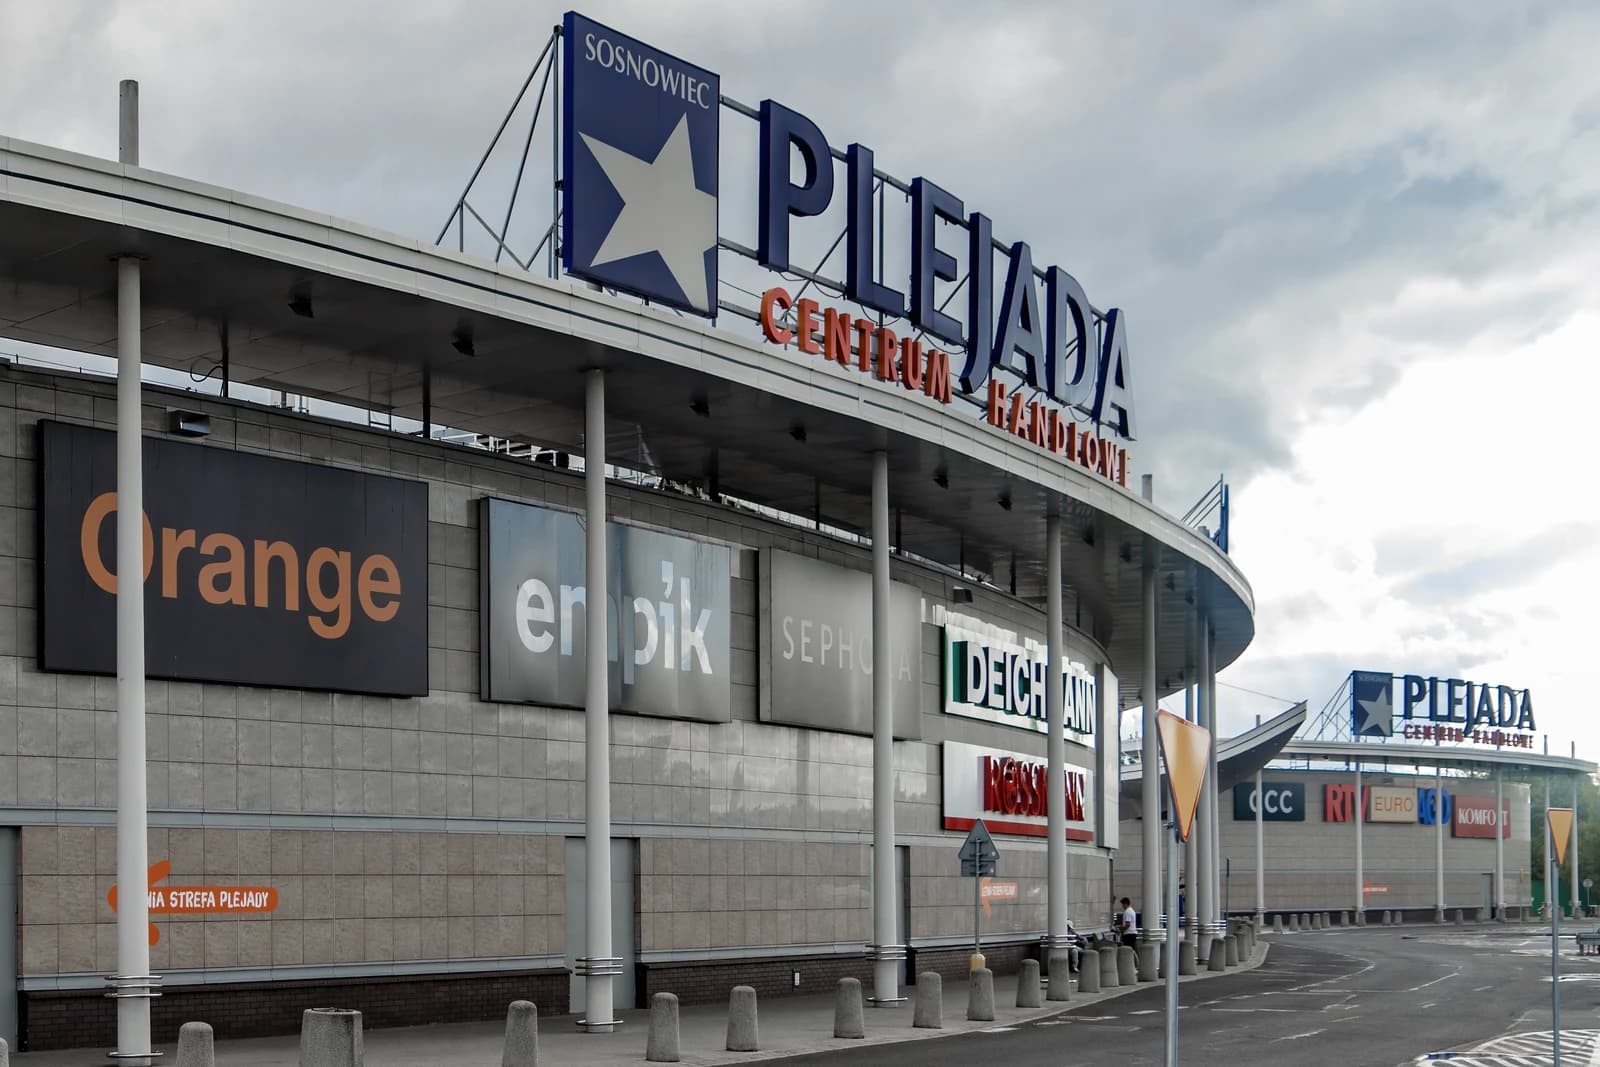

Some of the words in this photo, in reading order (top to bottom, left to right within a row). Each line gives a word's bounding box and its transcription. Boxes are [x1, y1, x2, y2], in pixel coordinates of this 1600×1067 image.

[585, 33, 711, 110] SOSNOWIEC
[758, 99, 1137, 441] PLEJADA
[761, 287, 953, 404] CENTRUM
[81, 491, 401, 640] Orange
[783, 615, 912, 681] SEPHOA
[953, 641, 1096, 735] DEICHANN
[1403, 674, 1536, 737] PLEJADA
[983, 755, 1085, 821] ROSSNN
[1249, 789, 1293, 813] CCC
[1375, 796, 1414, 812] EURO
[1458, 807, 1508, 826] KOMFOT
[169, 890, 216, 908] STREFA
[219, 890, 269, 908] PLEJADY
